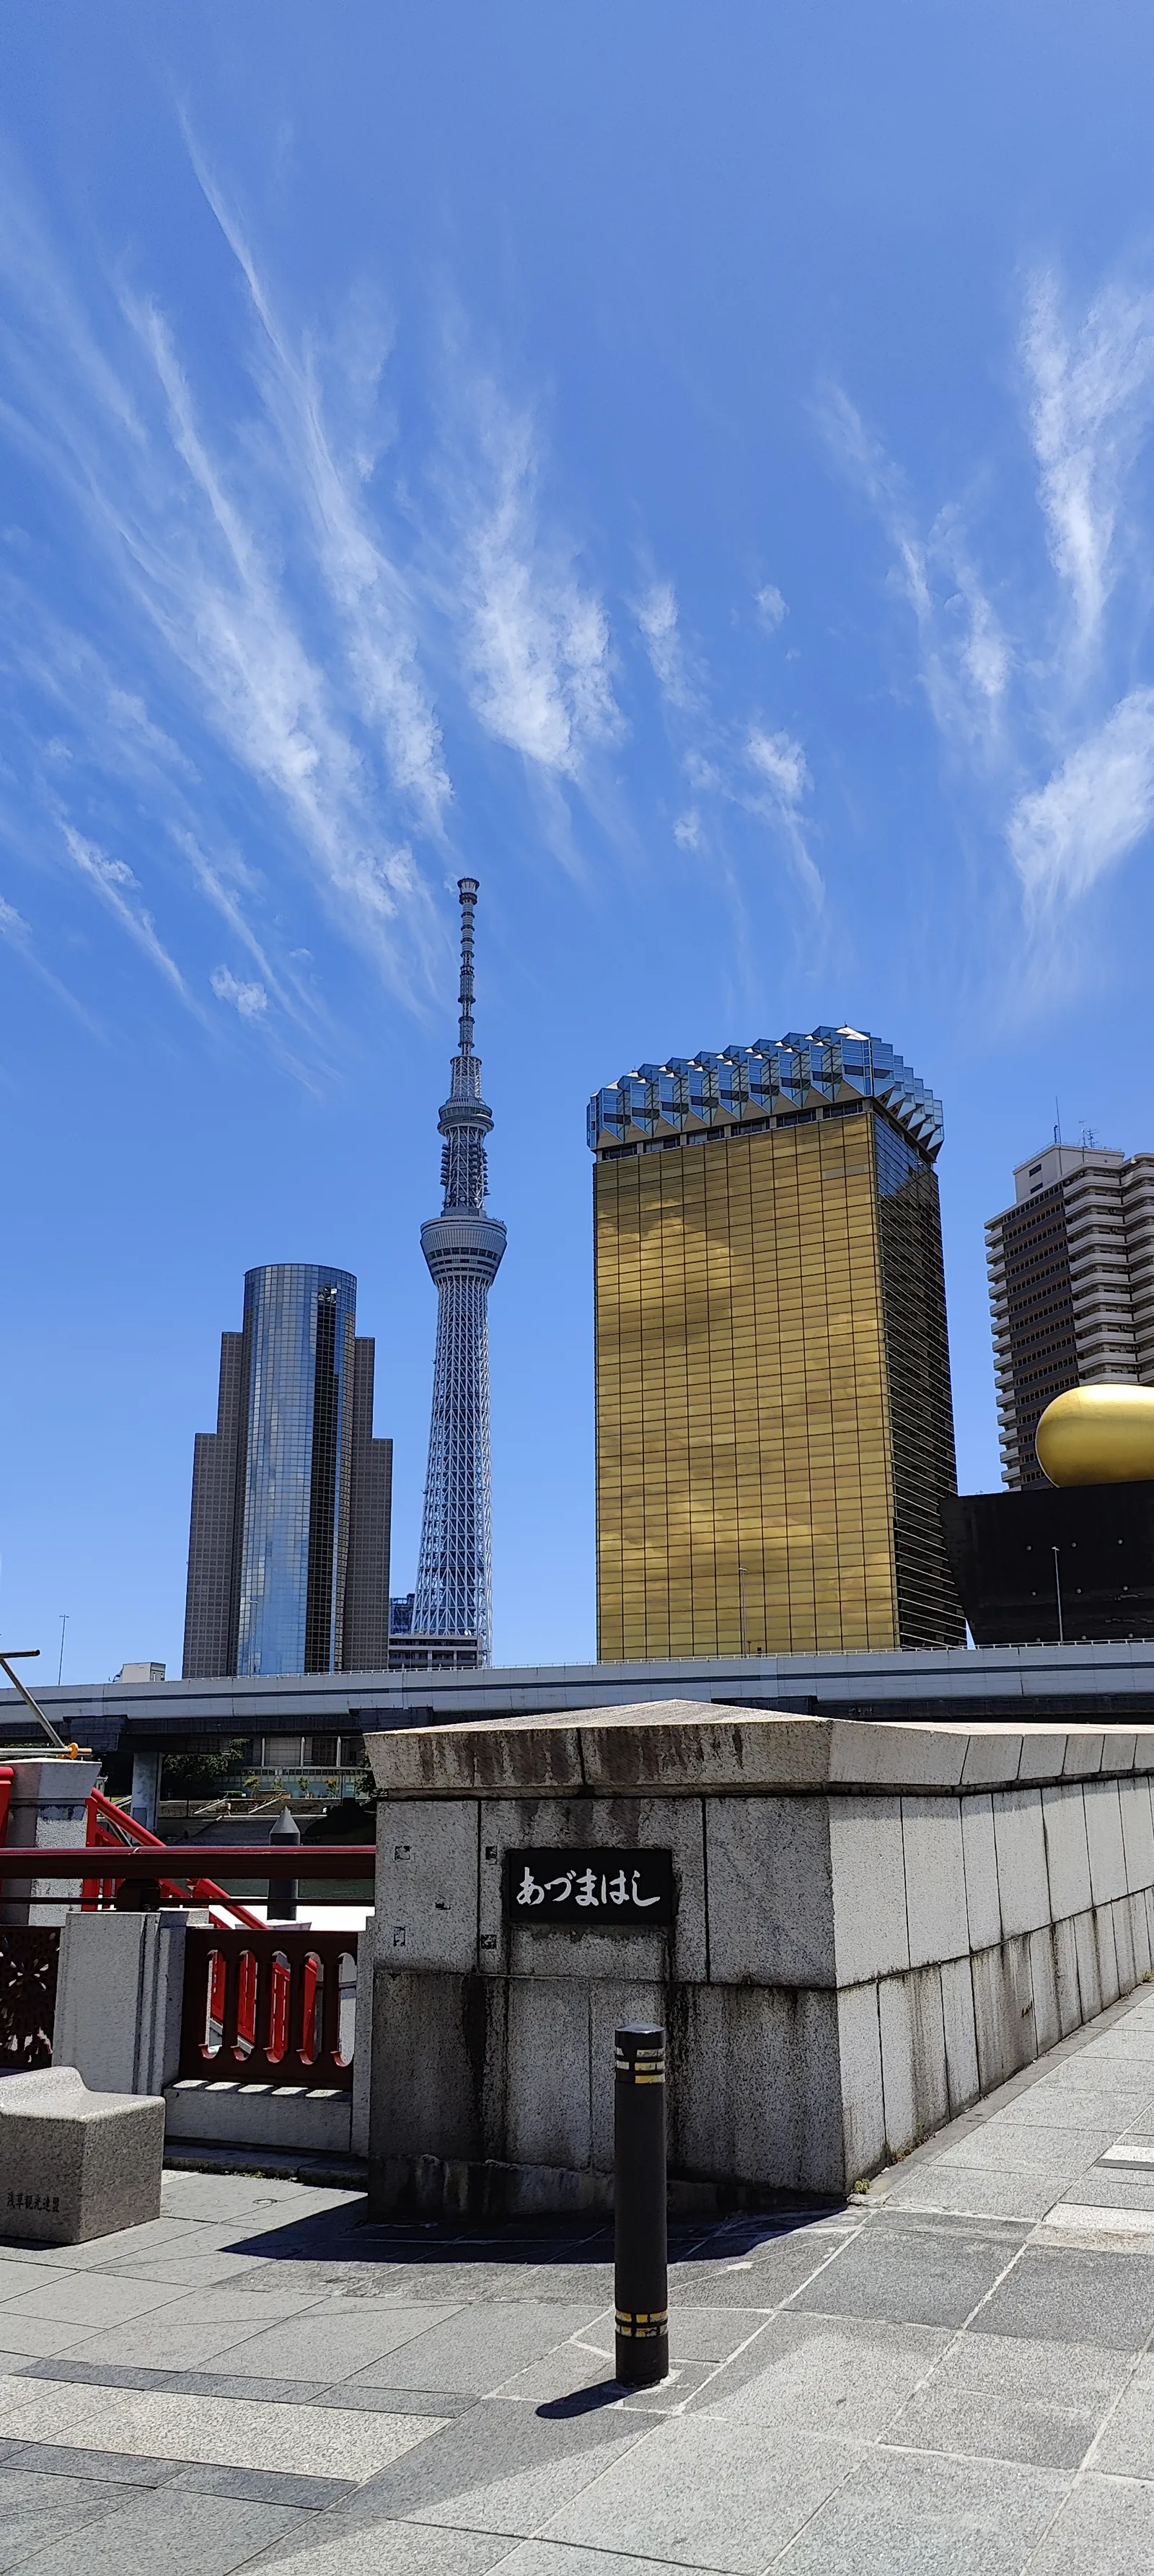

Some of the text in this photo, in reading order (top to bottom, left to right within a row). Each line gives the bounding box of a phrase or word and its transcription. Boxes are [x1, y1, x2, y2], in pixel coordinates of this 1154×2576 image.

[516, 1866, 661, 1907] あづまはし
